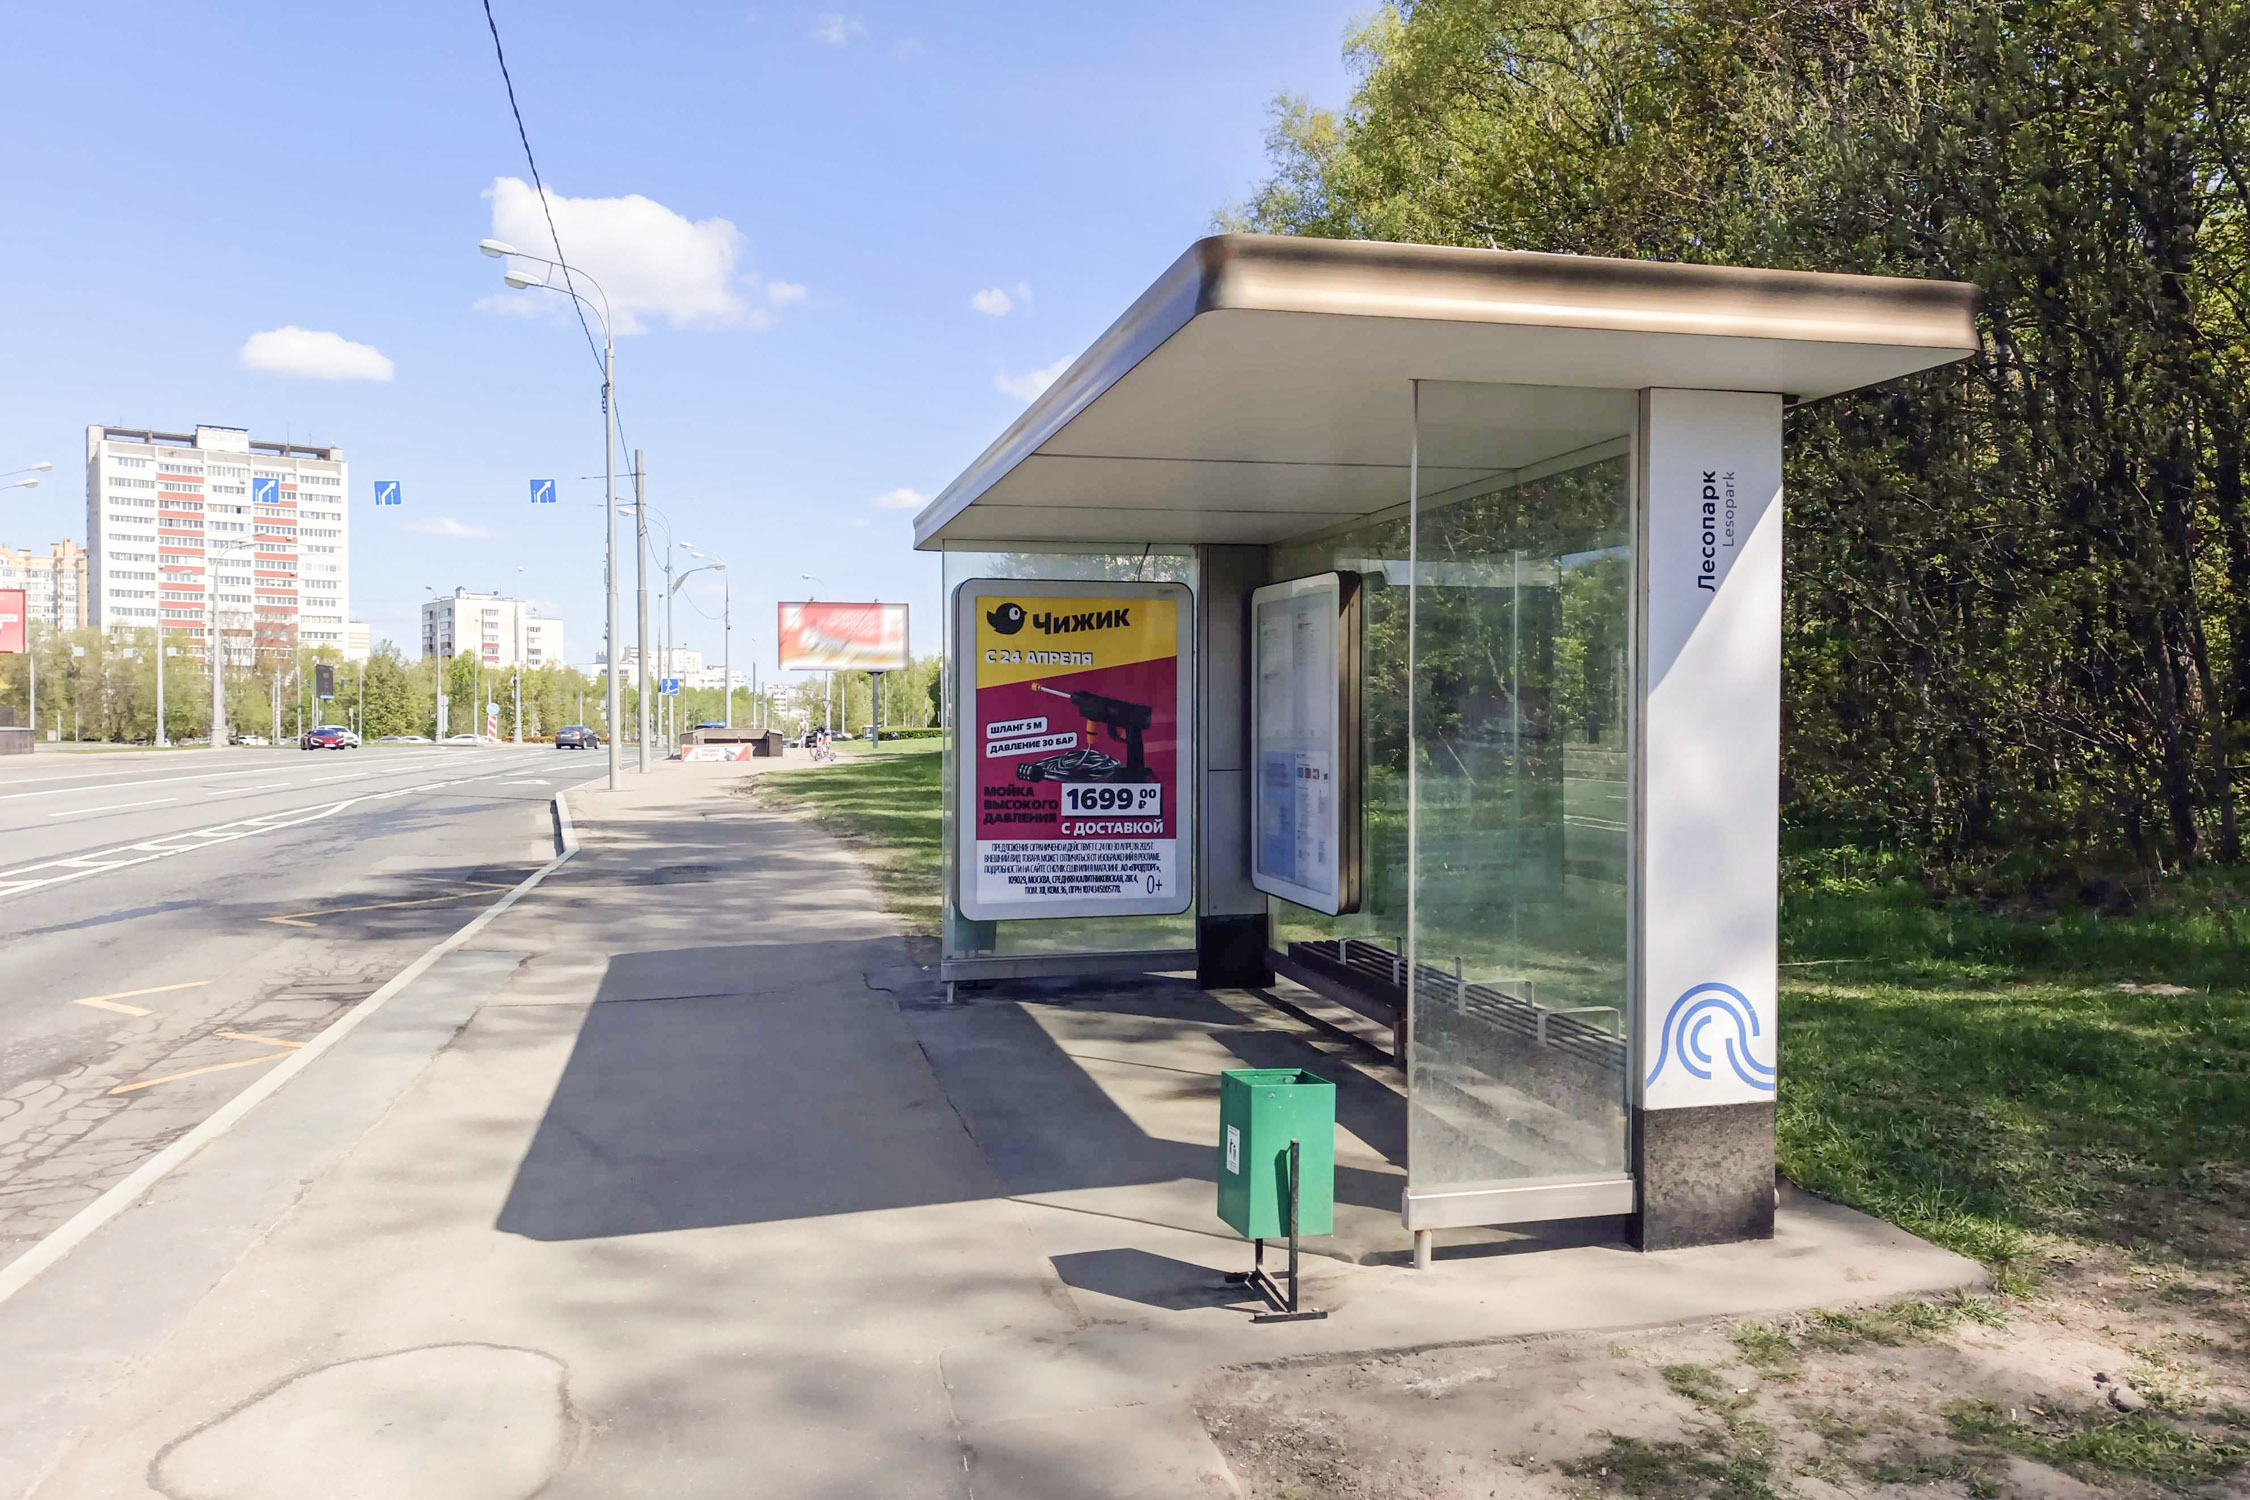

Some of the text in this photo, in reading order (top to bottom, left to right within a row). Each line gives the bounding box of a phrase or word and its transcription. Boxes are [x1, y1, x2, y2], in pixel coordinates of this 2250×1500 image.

[1722, 471, 1737, 547] Lesopark
[1698, 470, 1719, 592] Лесопарк
[1032, 608, 1130, 635] Чижик
[985, 649, 1094, 665] С 24 АПРЕЛЯ
[990, 721, 1042, 734] ШЛАНГ 5 М
[990, 736, 1074, 754] ДАВЛЕНИЕ 30 БАР
[984, 783, 1034, 797] МОЙКА
[1066, 788, 1157, 810] 1699 00
[983, 799, 1059, 810] ВЫСОКОГО
[983, 812, 1057, 825] ДАВЛЕНИЯ
[1061, 818, 1164, 836] С ДОСТАВКОЙ
[1146, 874, 1163, 895] 0+
